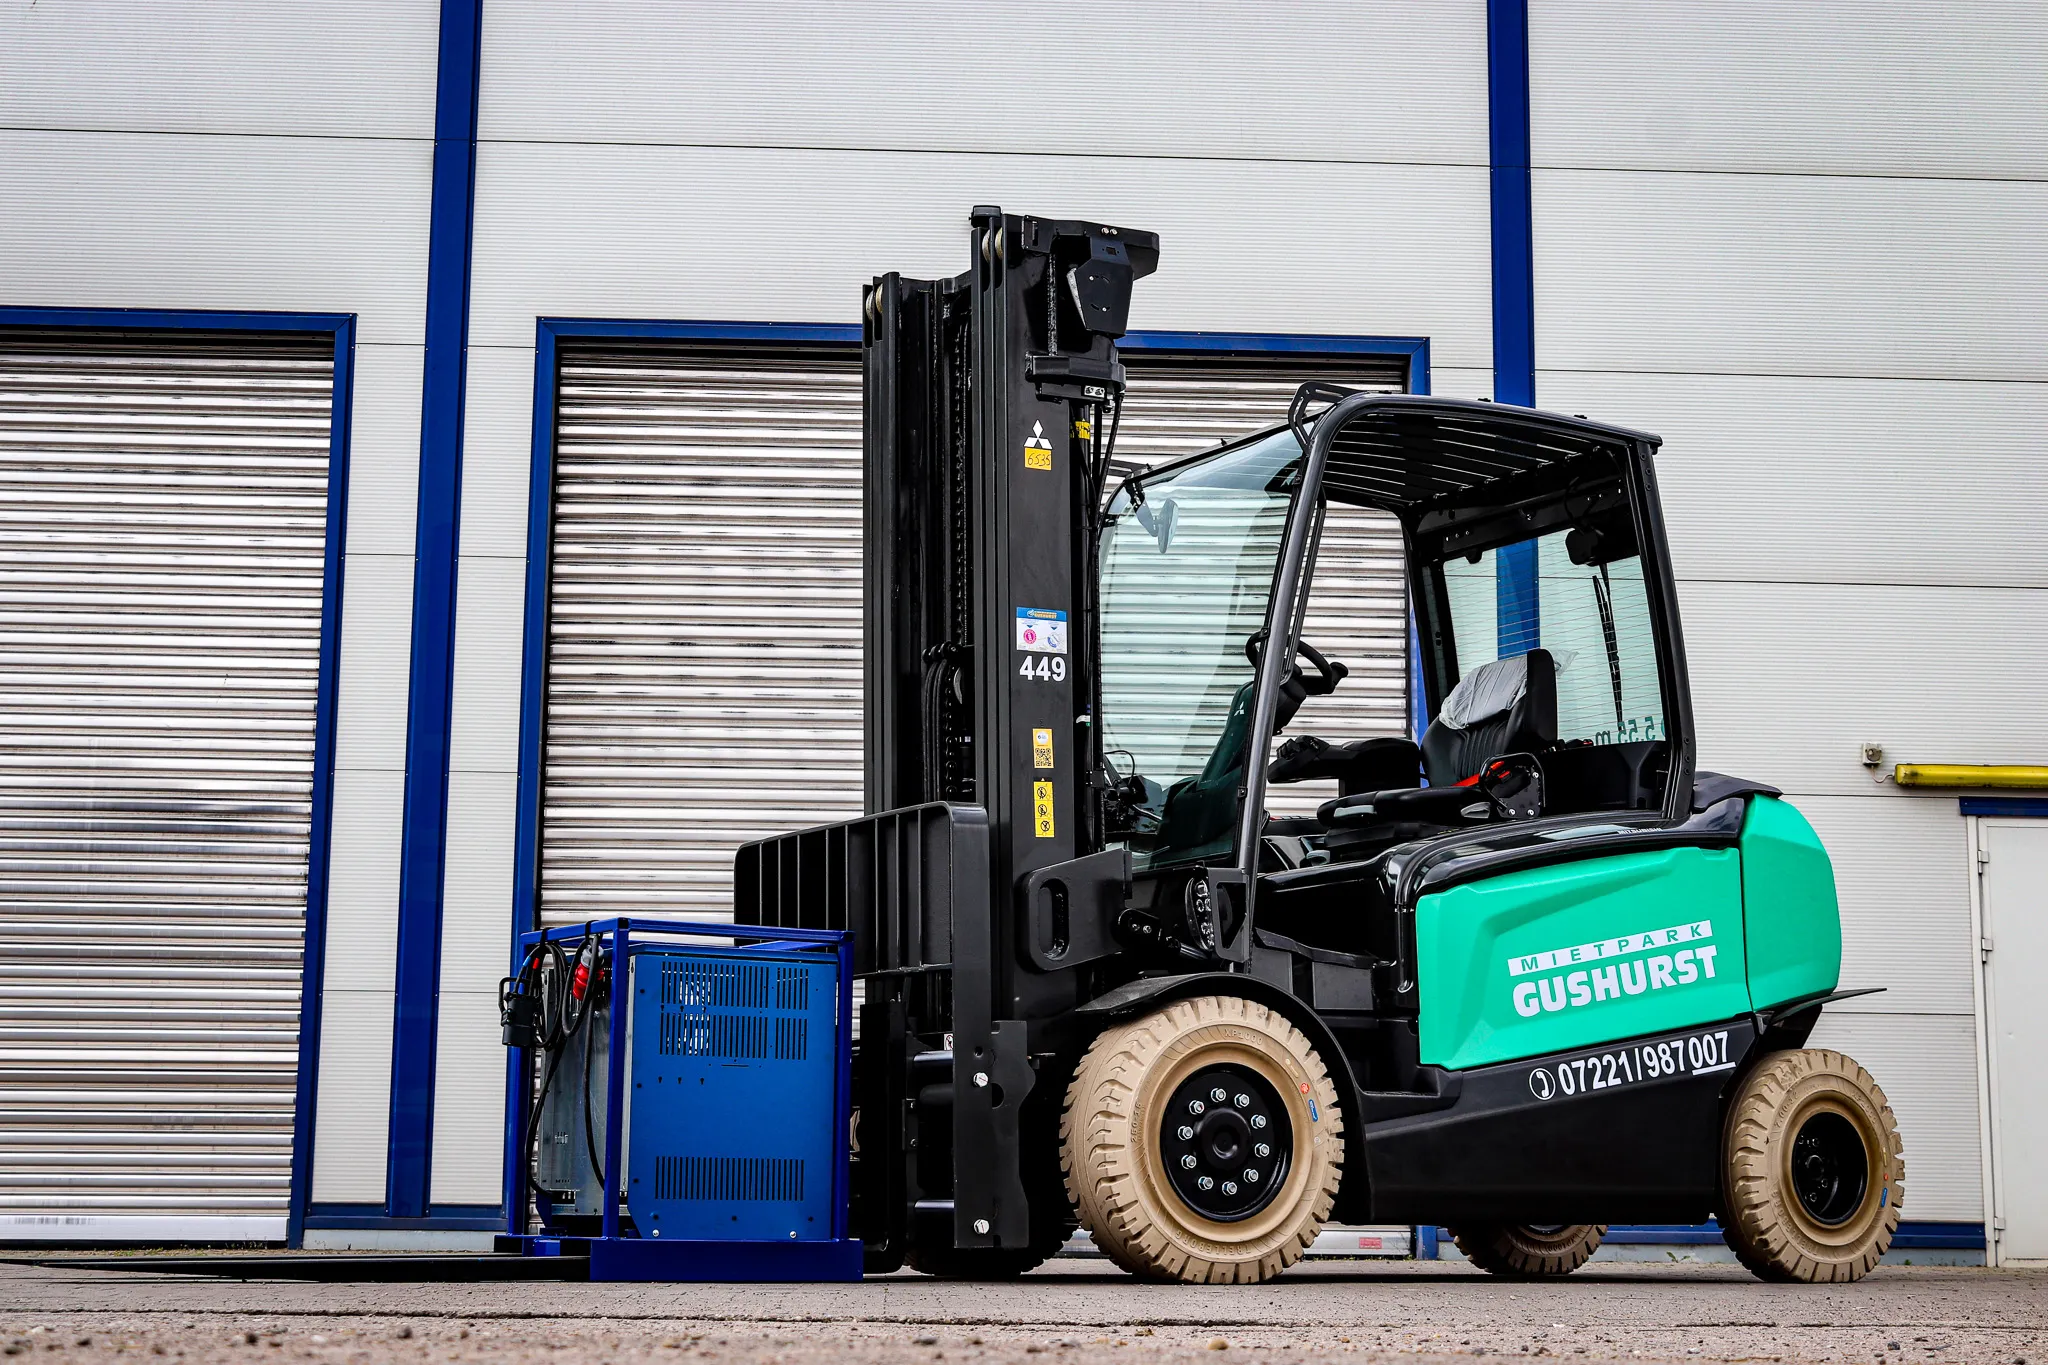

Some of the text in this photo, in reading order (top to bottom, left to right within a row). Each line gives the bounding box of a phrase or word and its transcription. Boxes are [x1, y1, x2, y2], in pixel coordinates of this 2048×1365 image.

[1027, 452, 1051, 467] 6535
[1020, 655, 1066, 682] 449
[1616, 827, 1663, 835] MITSUBISHI
[1520, 923, 1704, 972] MIETPARK
[1512, 944, 1718, 1018] GUSHURST
[1224, 1028, 1263, 1046] XP1000
[1175, 1230, 1251, 1255] TRELLEBORG
